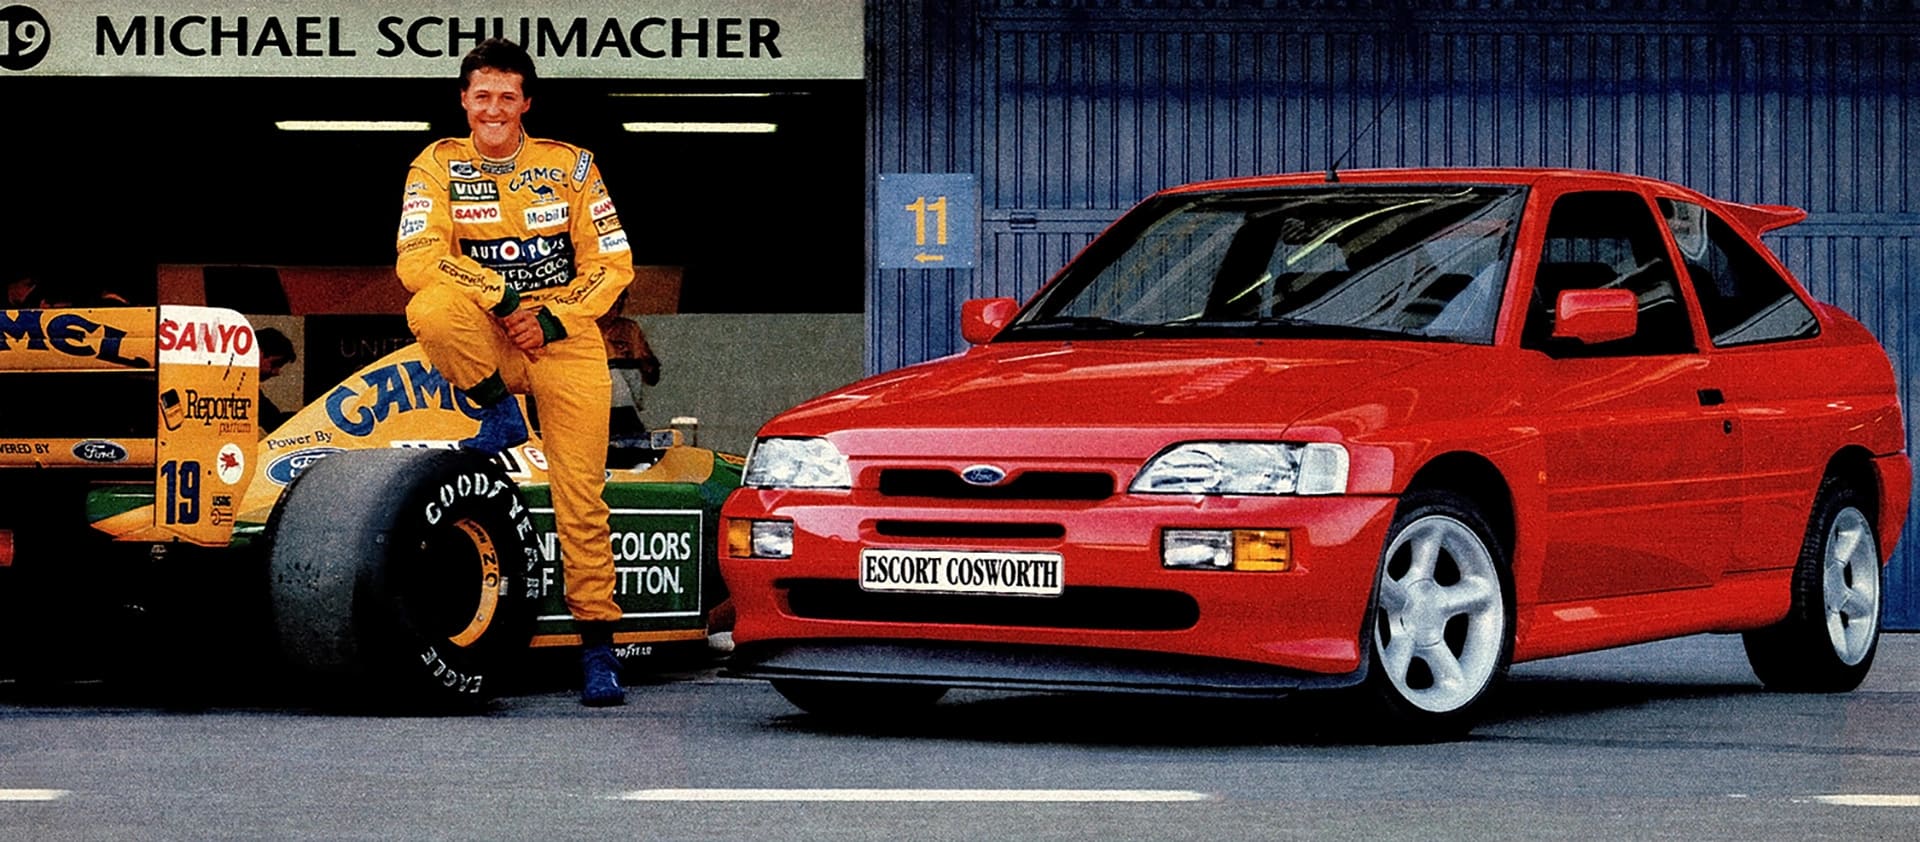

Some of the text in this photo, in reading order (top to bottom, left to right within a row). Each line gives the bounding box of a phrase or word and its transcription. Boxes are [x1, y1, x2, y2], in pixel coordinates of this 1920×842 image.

[0, 21, 45, 56] 19
[96, 15, 781, 58] MICHAEL SCHUMACHER
[454, 182, 497, 195] VIVIL
[403, 200, 430, 212] ANYO
[455, 207, 497, 219] SANYO
[527, 208, 559, 225] Mobil
[905, 196, 947, 246] 11
[159, 320, 253, 356] SANYO
[184, 389, 251, 426] Reporter
[34, 443, 49, 454] BY
[84, 443, 117, 459] Ford
[267, 430, 333, 450] Power By
[160, 460, 200, 525] 19
[610, 531, 691, 562] COLORS
[614, 565, 684, 596] TTON.
[865, 555, 1059, 588] ESCORT COSWORTH
[421, 646, 483, 693] EAGLE
